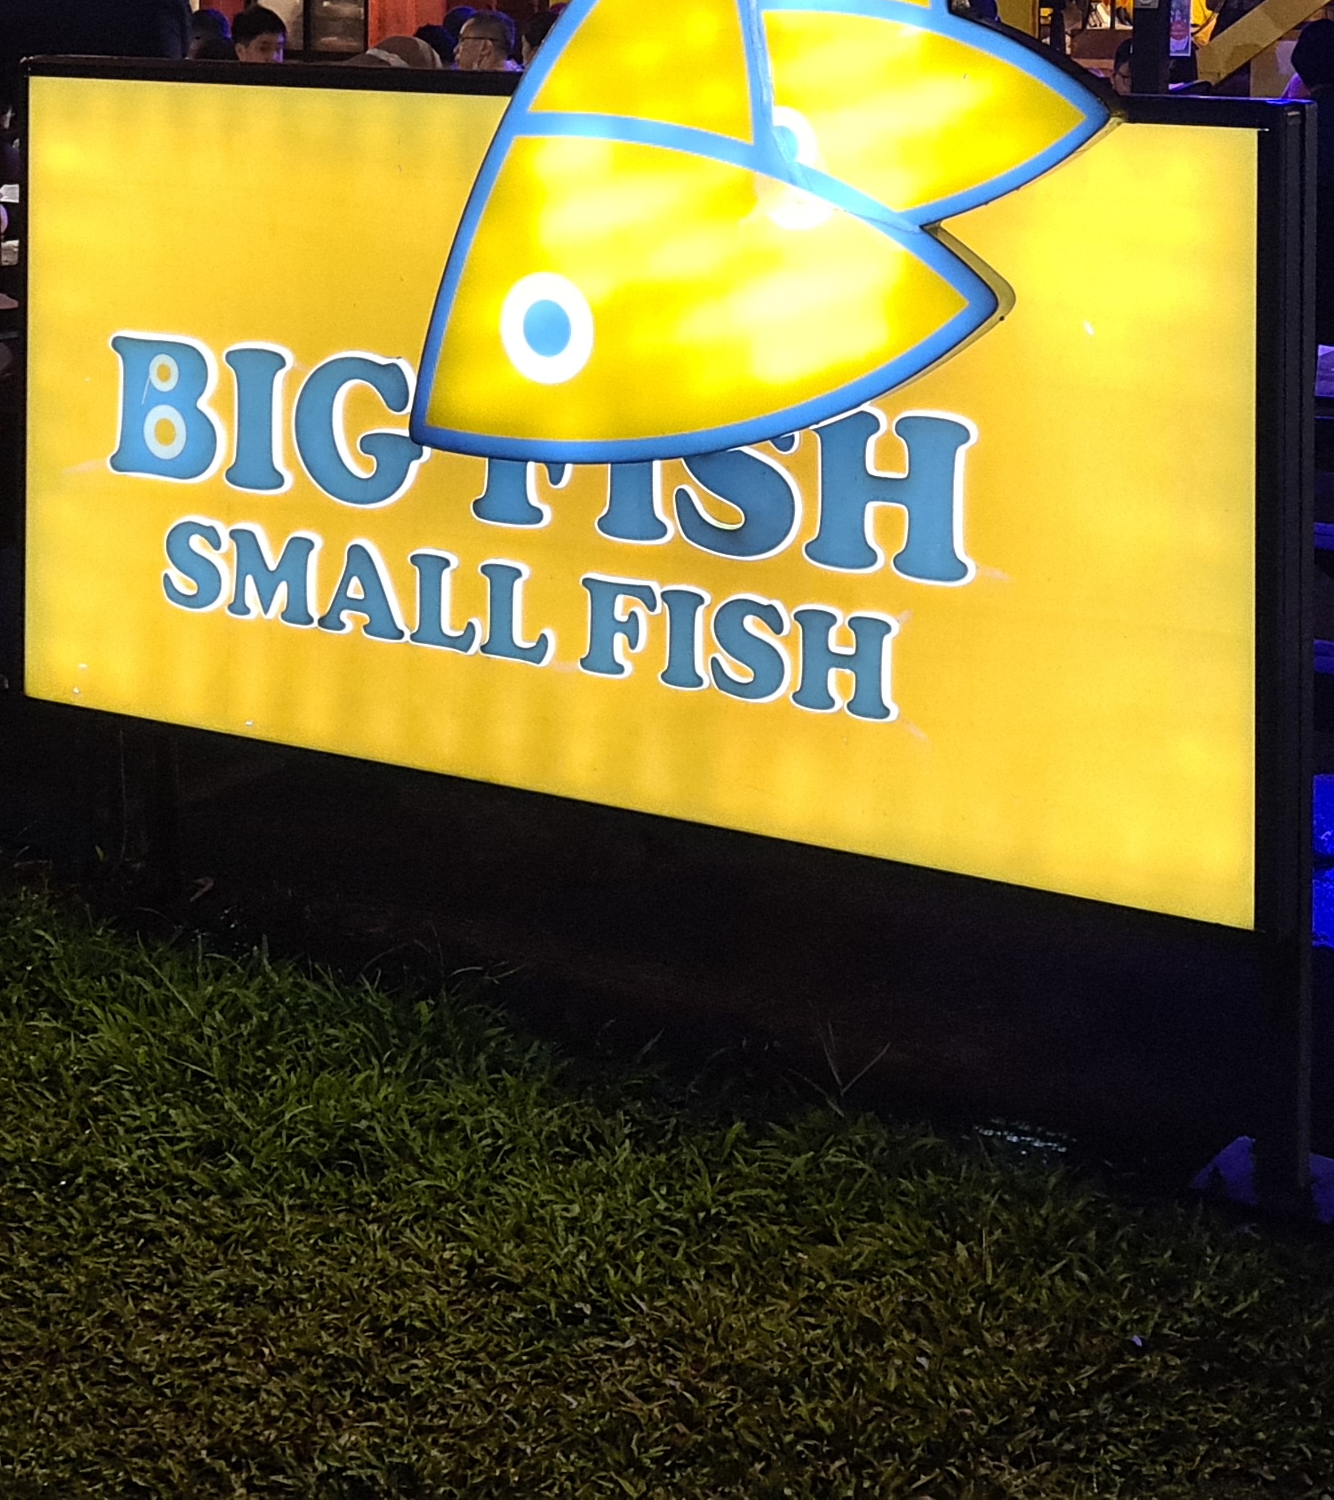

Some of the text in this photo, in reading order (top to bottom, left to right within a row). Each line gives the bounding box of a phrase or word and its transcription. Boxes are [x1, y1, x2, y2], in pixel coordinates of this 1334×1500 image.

[111, 332, 427, 506] BIG
[162, 515, 900, 721] SMALL FISH
